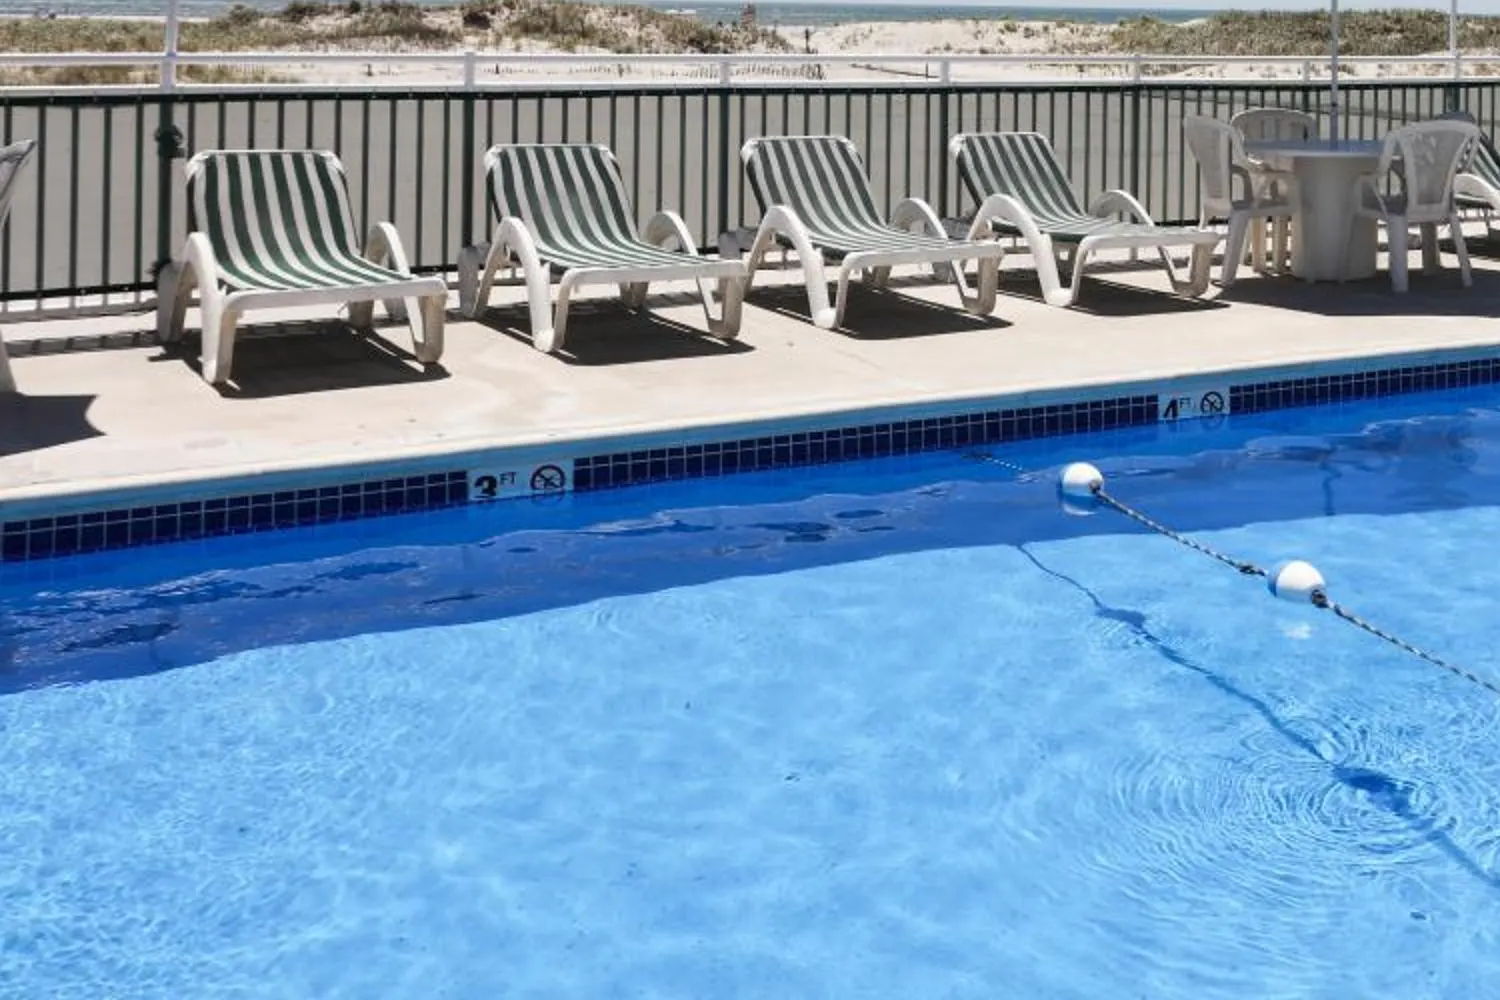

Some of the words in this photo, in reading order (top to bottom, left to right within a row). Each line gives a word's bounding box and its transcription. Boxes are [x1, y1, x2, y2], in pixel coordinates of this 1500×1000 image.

[1163, 398, 1179, 419] 4
[474, 474, 498, 499] 3
[499, 471, 518, 485] FT
